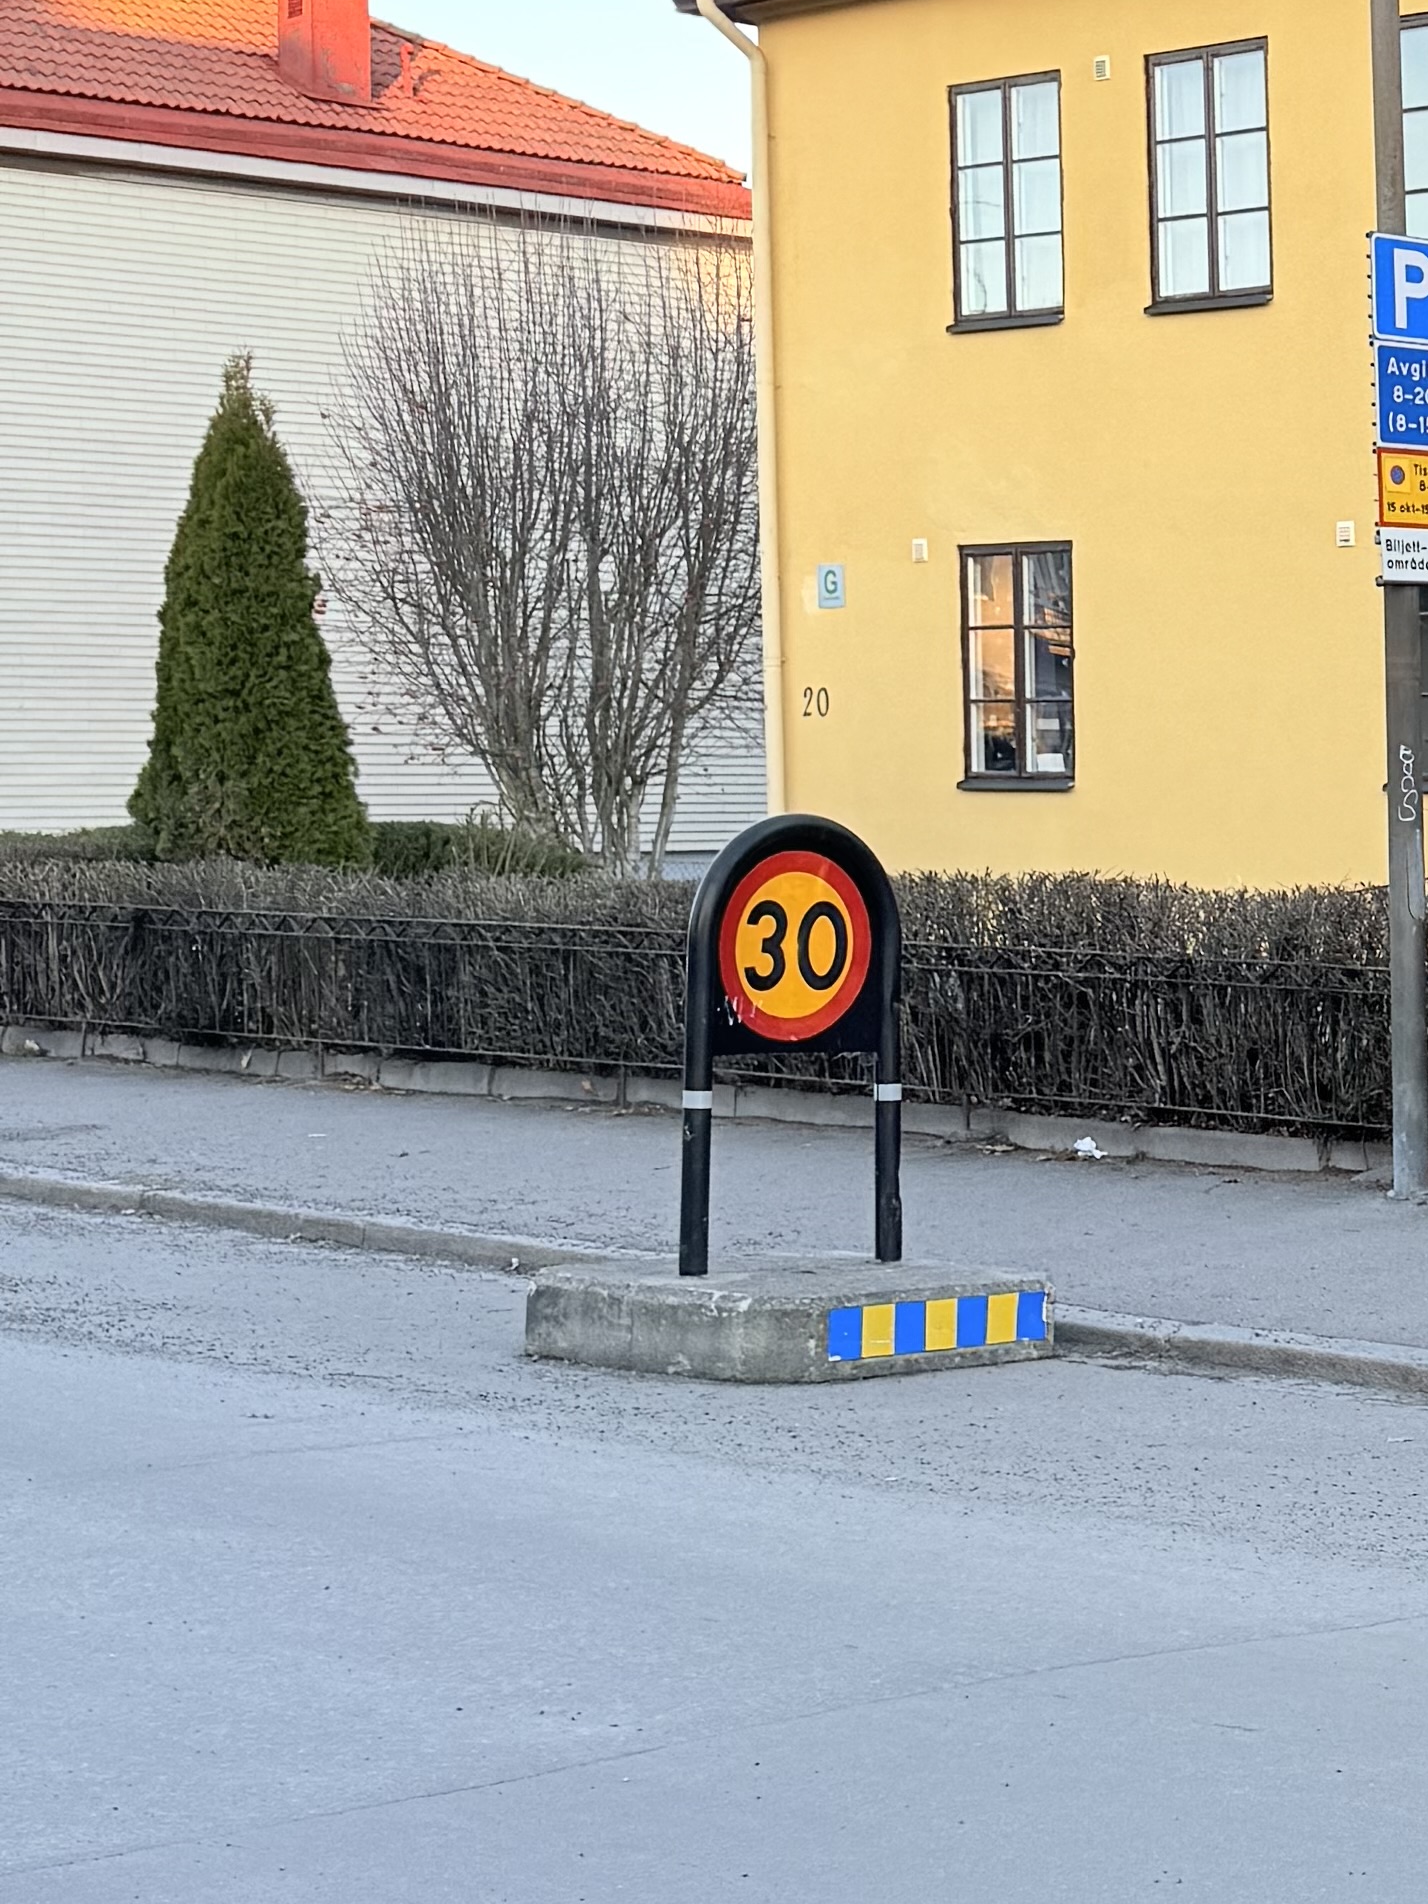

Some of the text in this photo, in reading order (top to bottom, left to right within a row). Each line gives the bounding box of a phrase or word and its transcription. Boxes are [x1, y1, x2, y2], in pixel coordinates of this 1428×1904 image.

[1386, 539, 1428, 555] Biljett-
[824, 569, 838, 595] G
[803, 687, 830, 717] 20
[744, 900, 849, 991] 30
